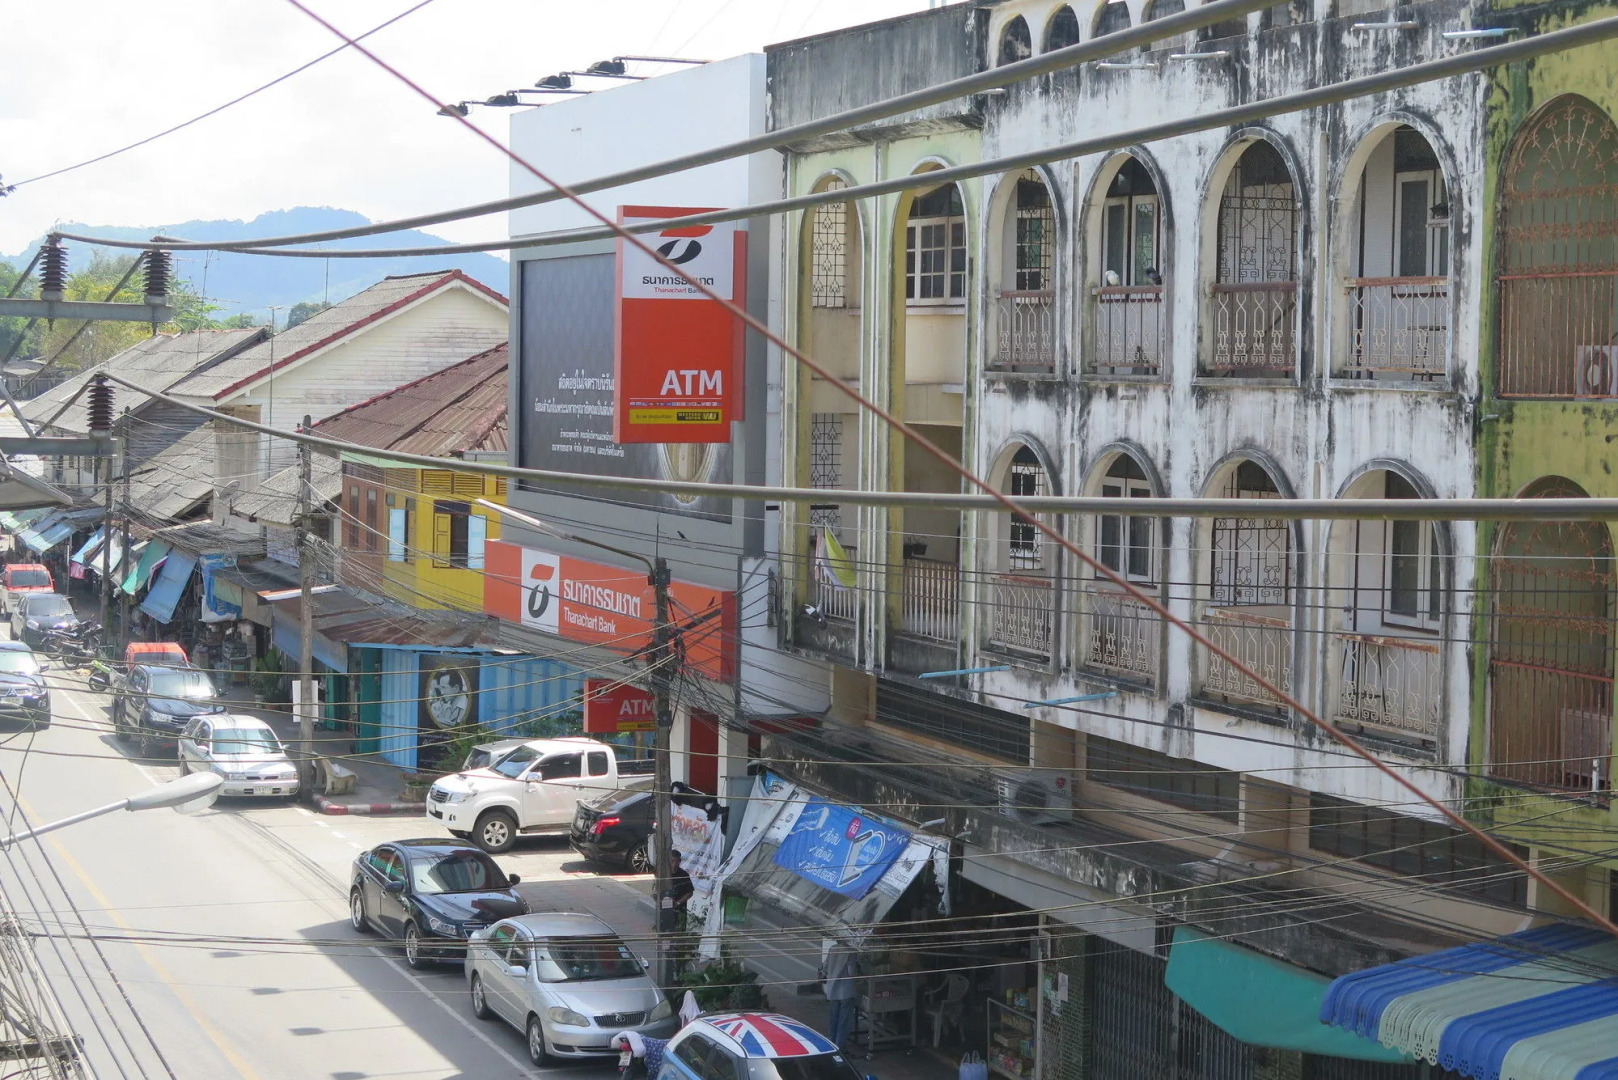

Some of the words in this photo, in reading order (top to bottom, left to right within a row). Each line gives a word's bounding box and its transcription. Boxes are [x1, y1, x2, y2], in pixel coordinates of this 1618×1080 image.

[642, 275, 714, 286] ธนาคารธาต
[654, 286, 687, 294] Thanachart
[687, 287, 704, 295] Ban
[660, 369, 723, 396] ATM
[563, 578, 641, 618] ธนาคารธนชาต
[563, 606, 598, 631] Thanachart
[598, 616, 617, 634] Bank
[619, 699, 656, 715] ATM
